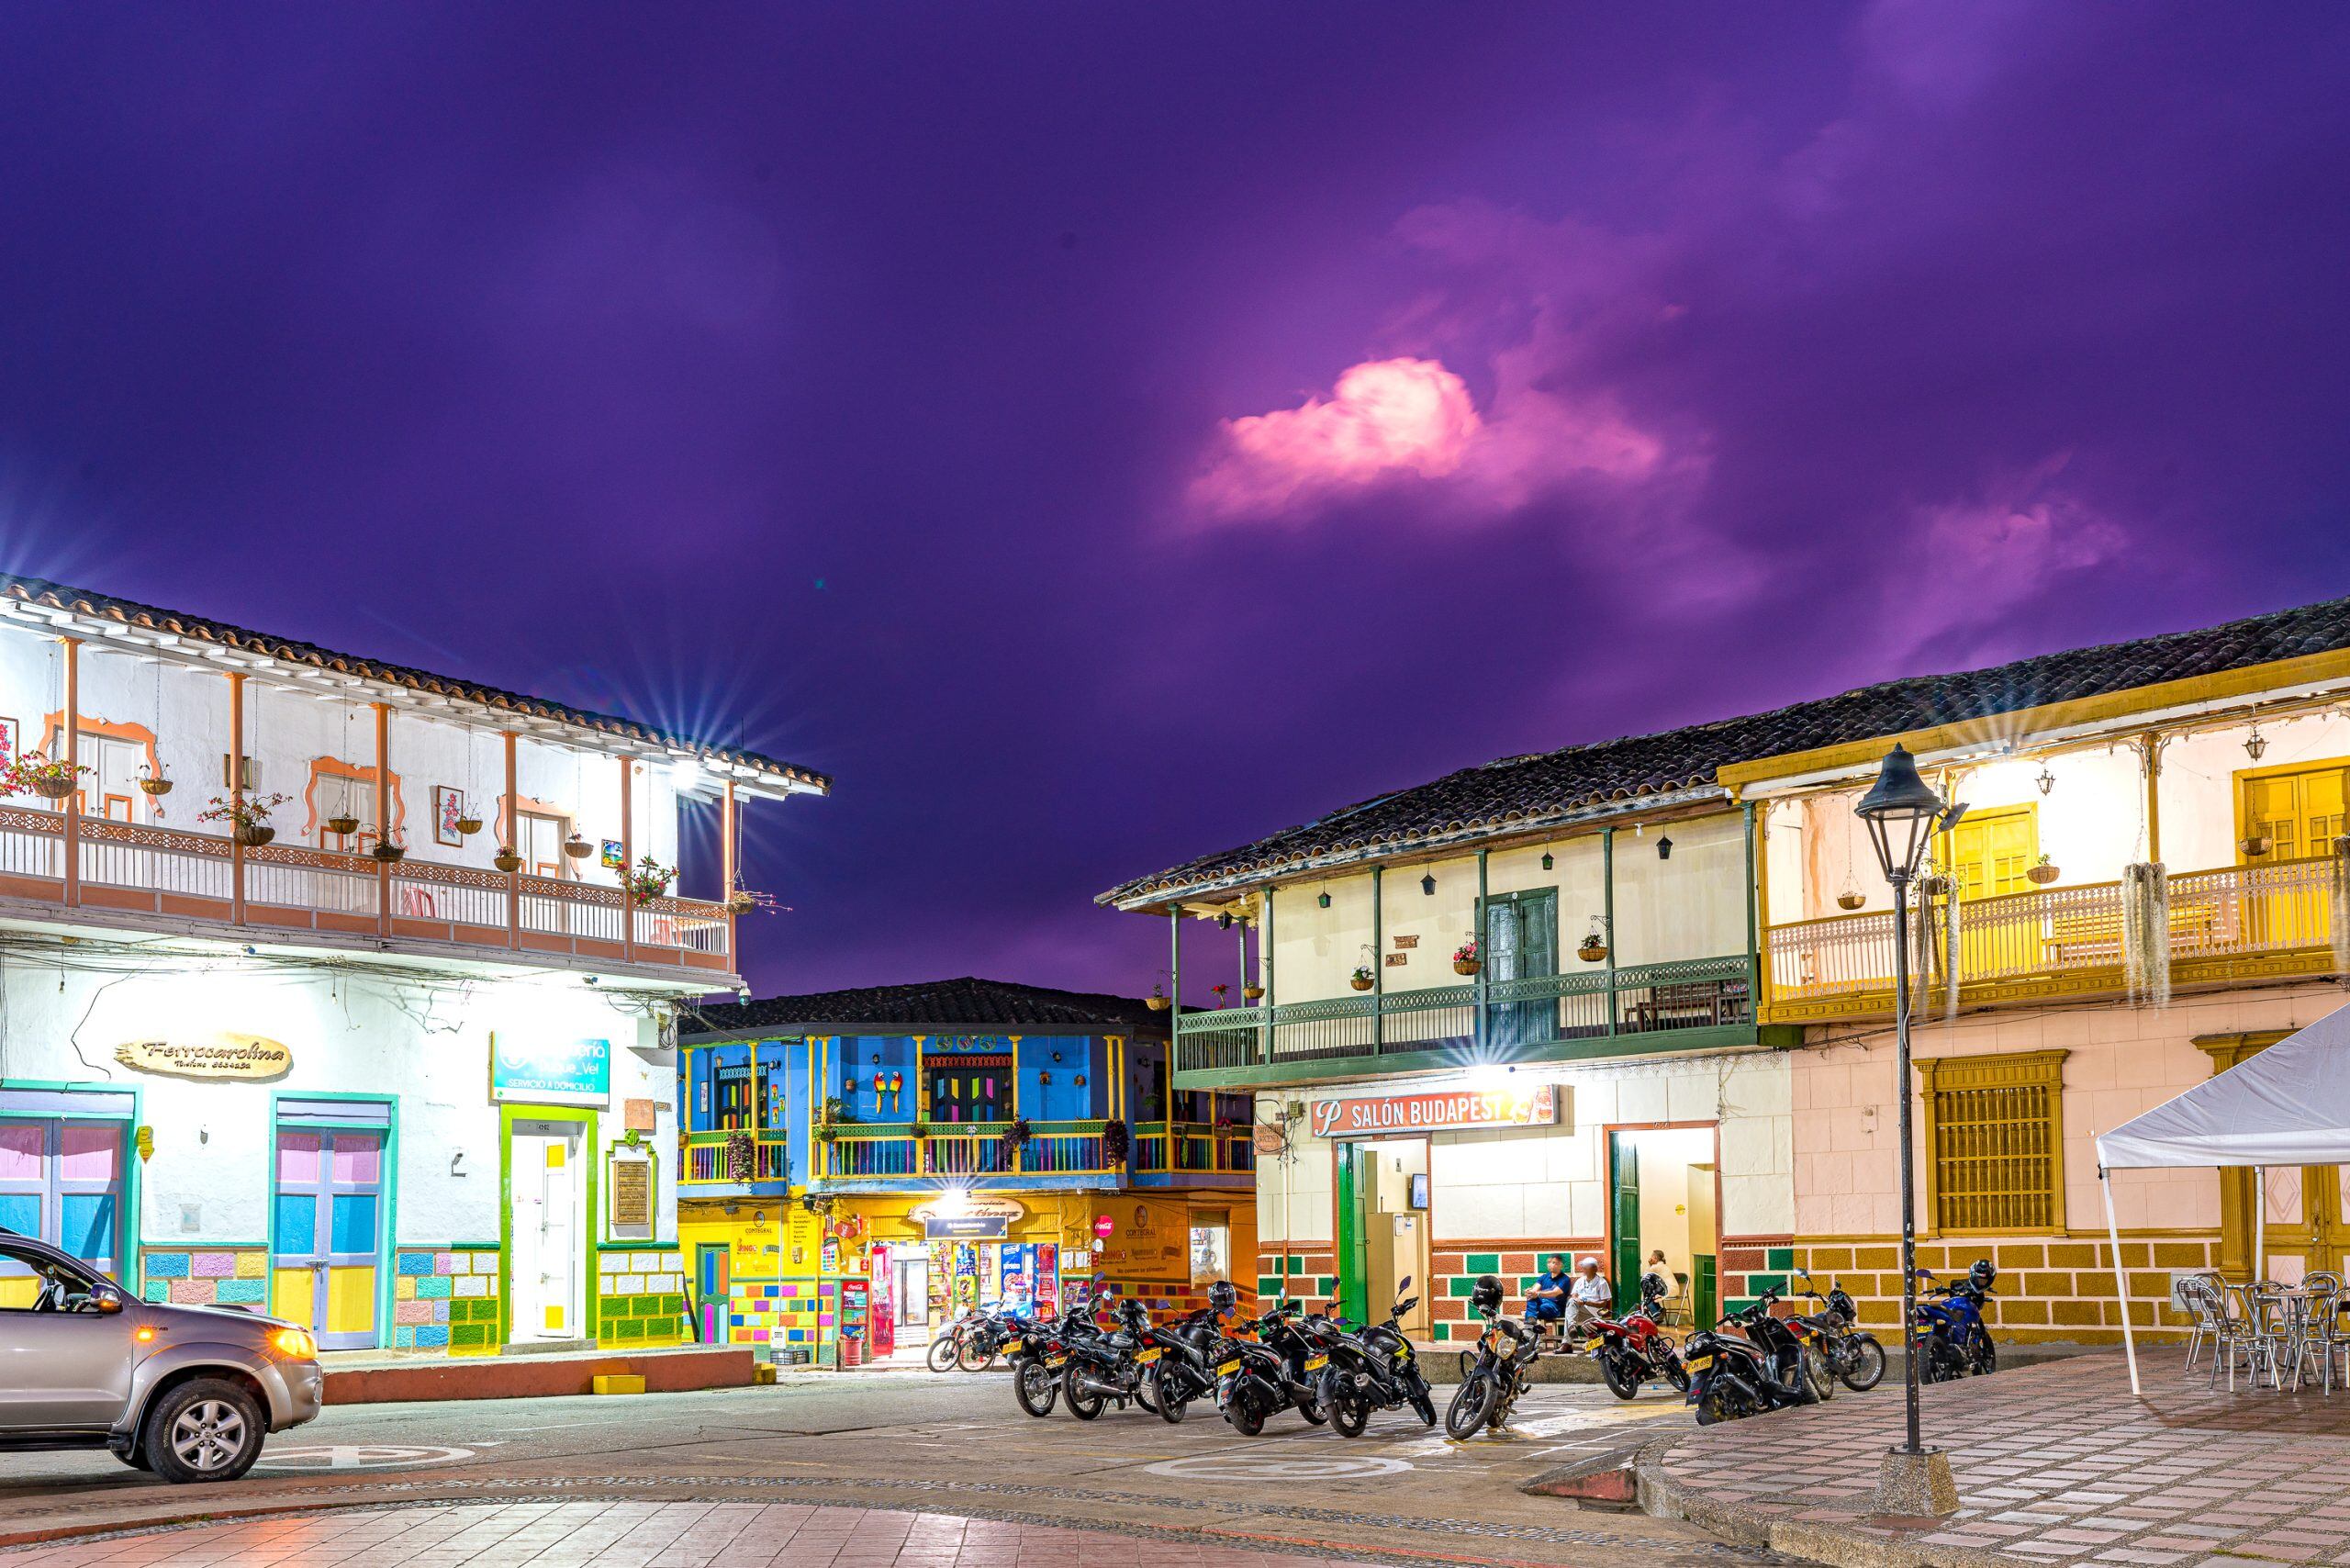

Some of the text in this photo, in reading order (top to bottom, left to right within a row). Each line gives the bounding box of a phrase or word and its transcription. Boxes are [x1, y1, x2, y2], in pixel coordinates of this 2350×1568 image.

[142, 1041, 285, 1061] Ferrocarolina
[509, 1079, 546, 1089] SERVICIO
[554, 1081, 595, 1092] DOMICILIO
[1351, 1098, 1404, 1128] SALÓN
[1410, 1095, 1503, 1125] BUDAPEST
[1125, 1228, 1157, 1237] CONTEGRAL
